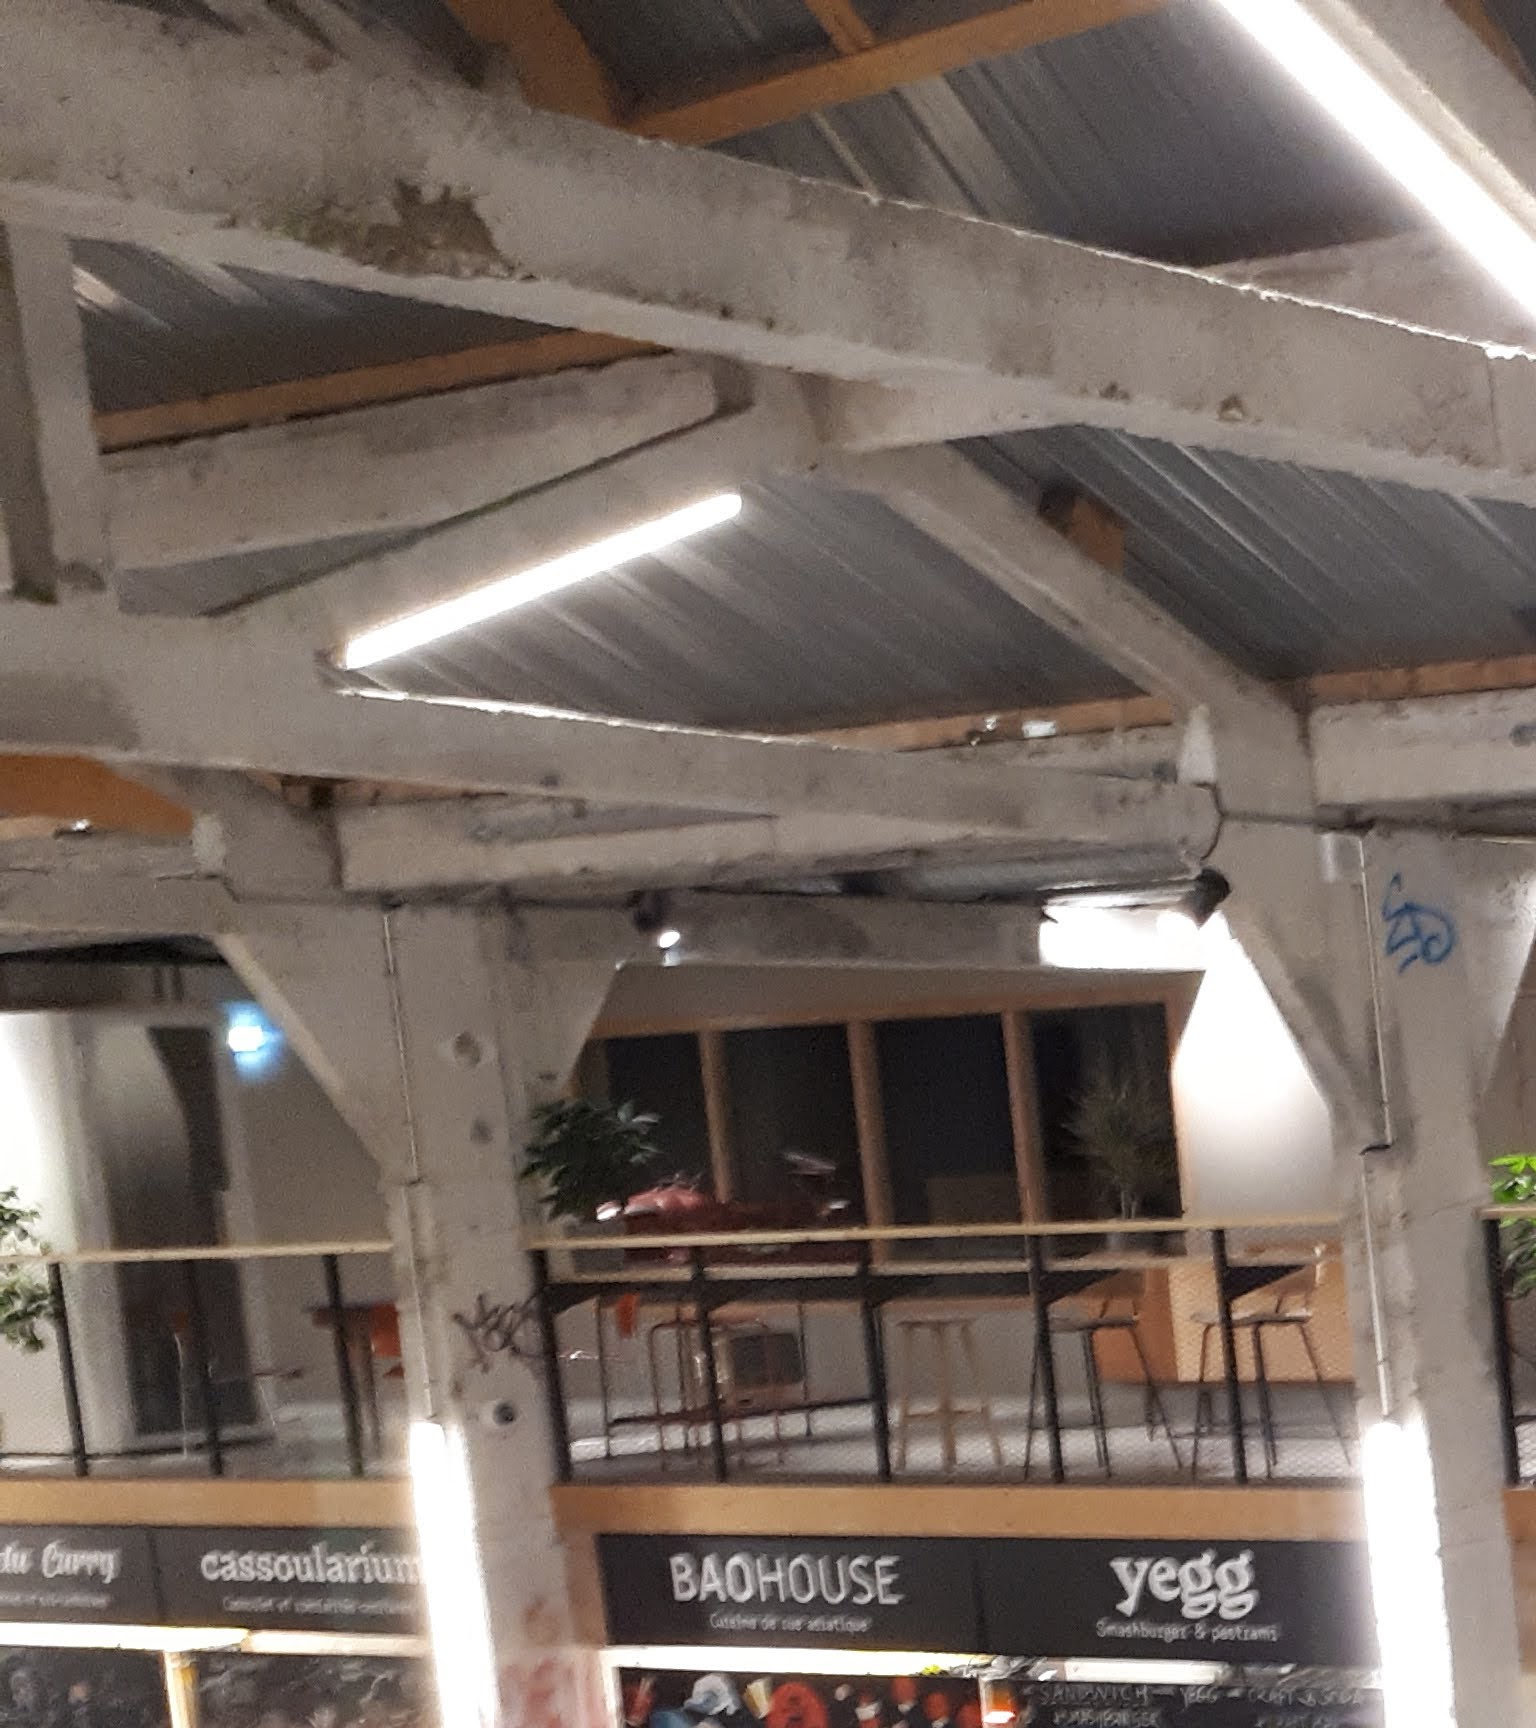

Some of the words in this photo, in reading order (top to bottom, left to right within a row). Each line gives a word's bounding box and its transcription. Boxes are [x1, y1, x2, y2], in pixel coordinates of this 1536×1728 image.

[41, 1540, 119, 1584] Curry
[668, 1553, 902, 1604] BAOHOUSE
[1109, 1550, 1259, 1620] yegg
[1096, 1617, 1189, 1642] Smashburger
[1195, 1619, 1207, 1640] &
[1212, 1621, 1281, 1643] pastrami
